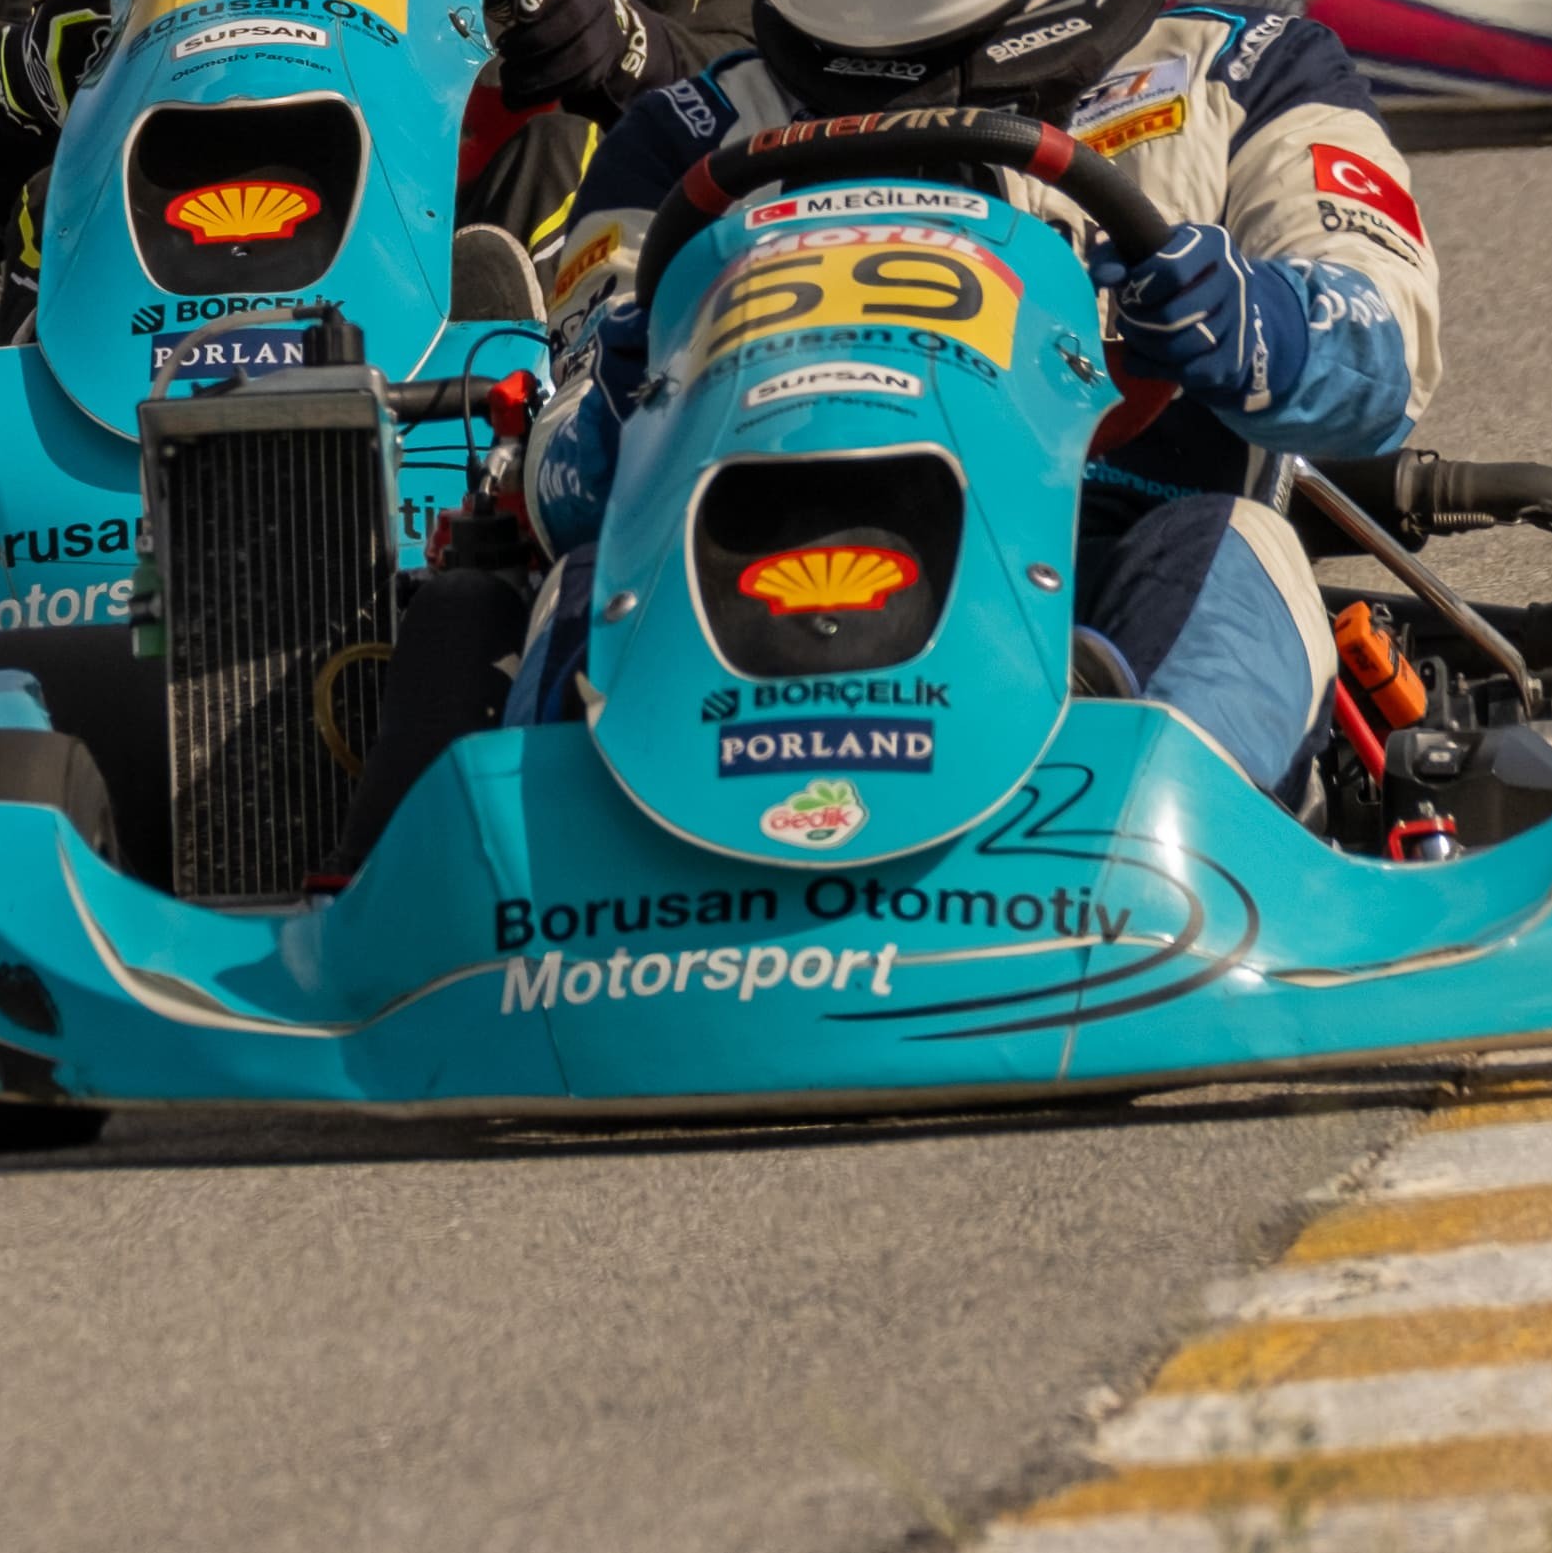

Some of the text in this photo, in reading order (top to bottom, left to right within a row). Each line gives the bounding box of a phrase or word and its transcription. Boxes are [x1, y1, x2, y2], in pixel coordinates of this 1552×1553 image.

[184, 24, 318, 52] SUPSAN
[987, 17, 1092, 64] sparco
[171, 52, 250, 82] Otomotiv
[824, 56, 926, 81] sparco
[807, 190, 982, 214] M.EĞİLMEZ
[747, 225, 984, 262] MOTUL
[706, 250, 984, 357] 59
[908, 330, 999, 381] Oto
[757, 370, 910, 398] SUPSAN
[754, 677, 950, 711] BORÇELİK
[720, 731, 933, 765] PORLAND
[493, 875, 1132, 953] Borusan Otomotiv
[500, 942, 898, 1016] Motorsport
